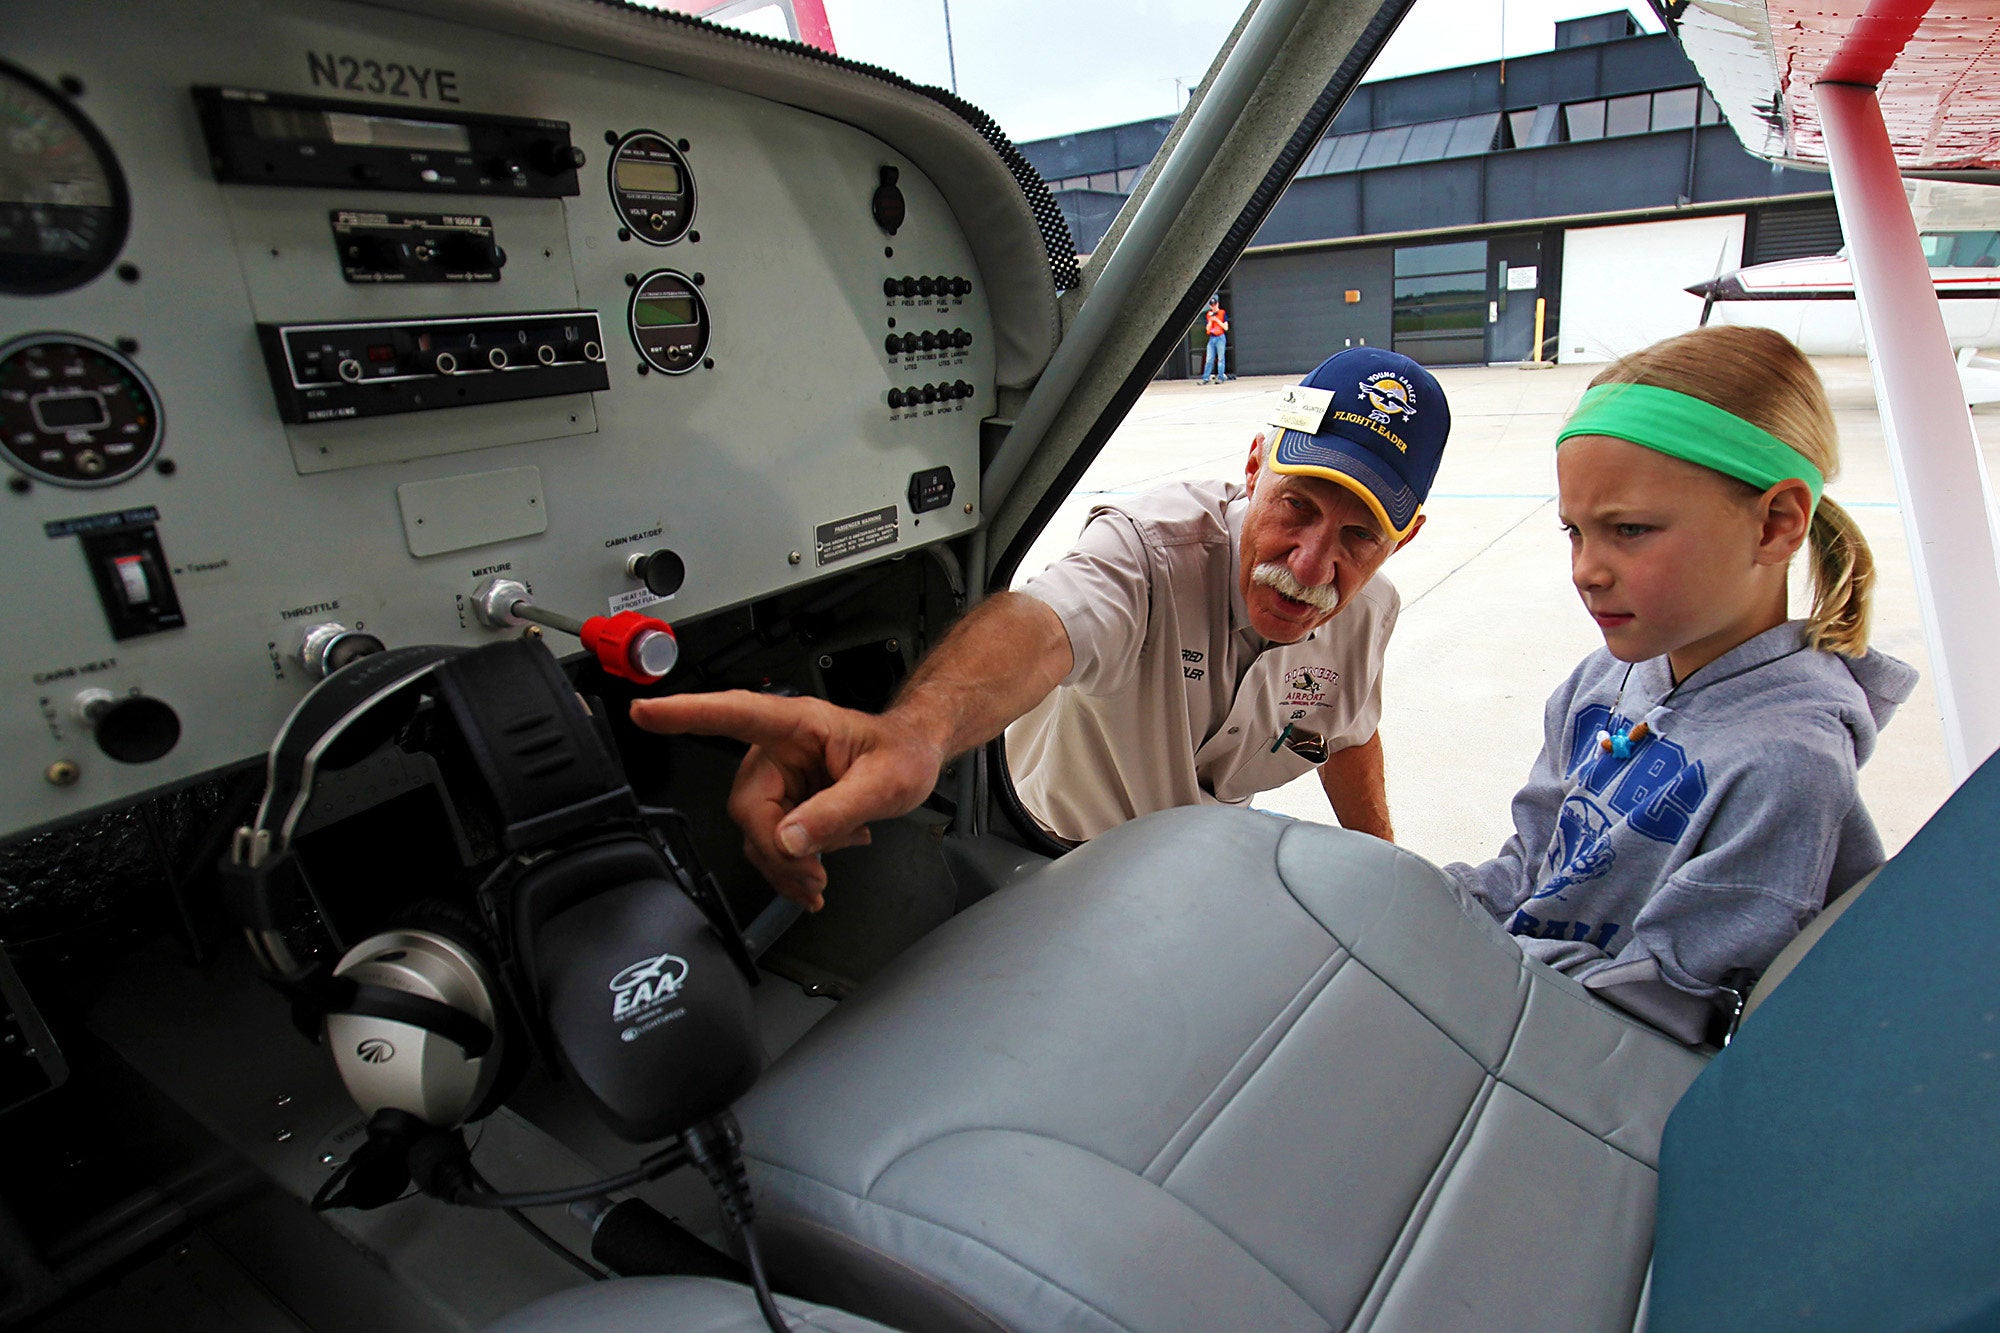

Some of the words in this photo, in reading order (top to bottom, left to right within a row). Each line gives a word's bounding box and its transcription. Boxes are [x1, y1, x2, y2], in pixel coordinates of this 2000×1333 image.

[307, 51, 461, 102] N232YE
[630, 208, 648, 216] VOLTS
[467, 332, 479, 349] 2
[518, 329, 528, 345] 0
[1367, 371, 1396, 383] YOUNG
[1398, 376, 1417, 405] EAGLES
[834, 520, 861, 533] PASSENGER
[605, 537, 628, 548] CABIN
[472, 562, 512, 577] MIXTURE
[613, 598, 641, 613] DEFROST
[642, 594, 657, 604] FULL
[621, 592, 637, 602] HEAT
[281, 600, 340, 619] THROTTLE
[455, 594, 466, 629] PULL
[1285, 667, 1340, 685] PIONEER
[1286, 692, 1326, 701] AIRPORT
[613, 971, 676, 1017] EAA
